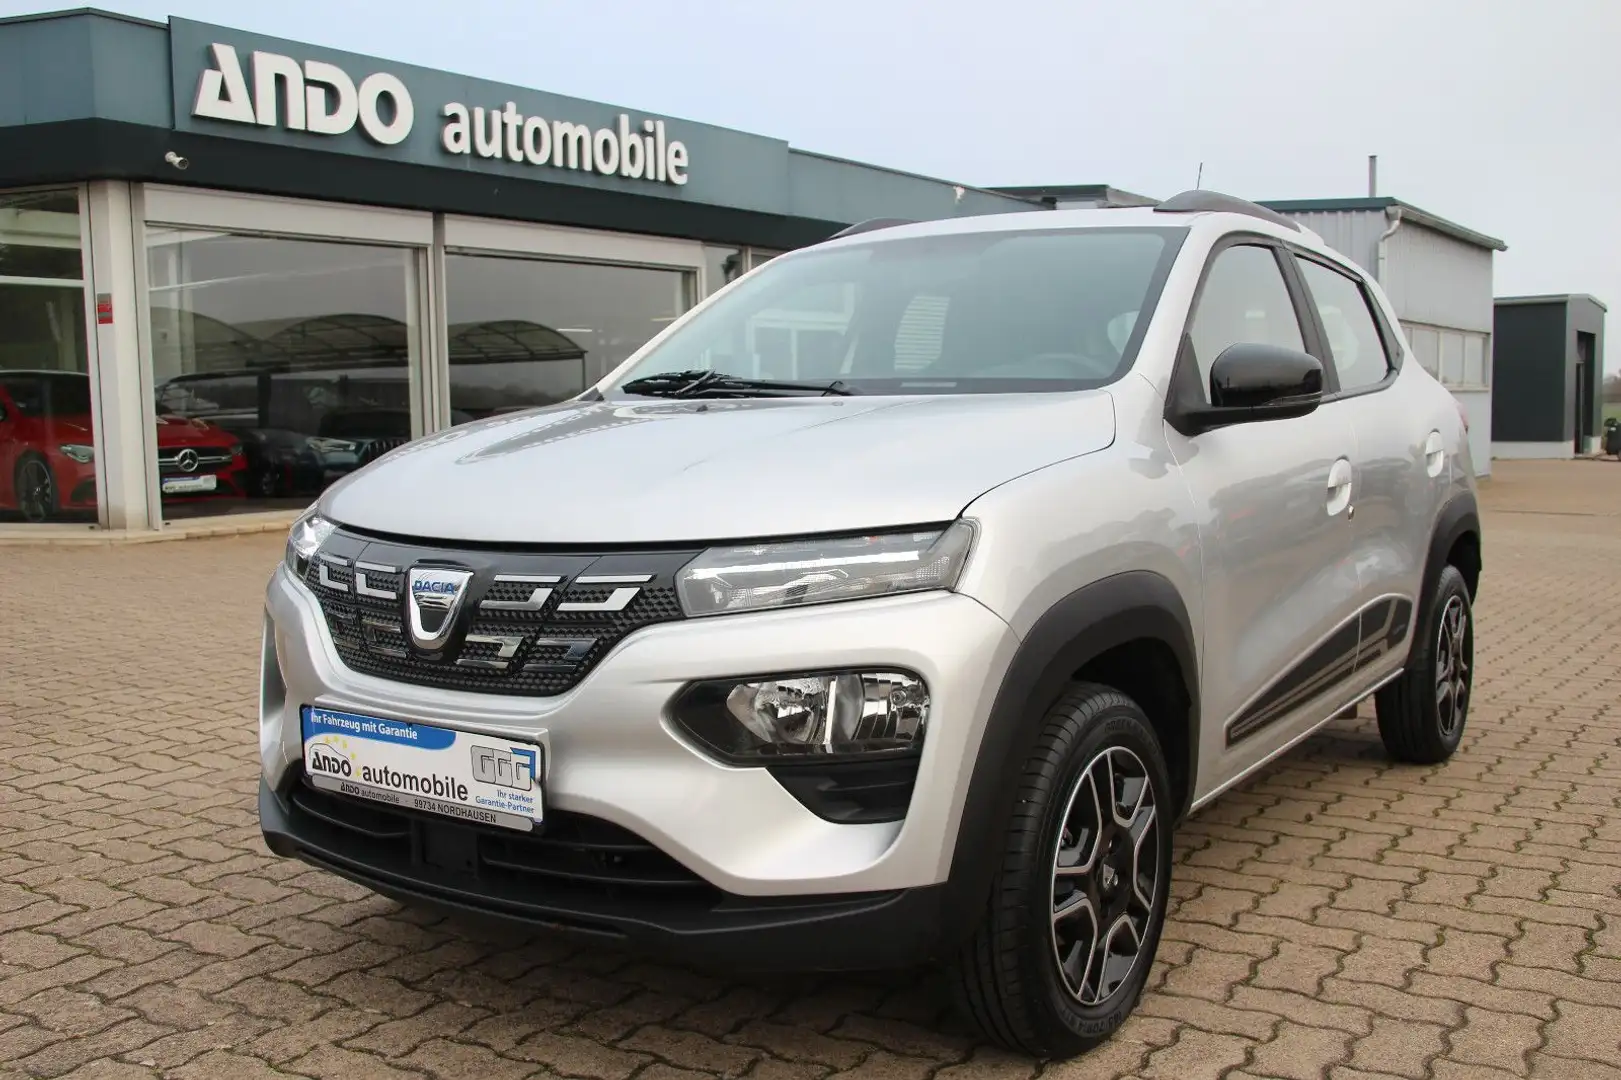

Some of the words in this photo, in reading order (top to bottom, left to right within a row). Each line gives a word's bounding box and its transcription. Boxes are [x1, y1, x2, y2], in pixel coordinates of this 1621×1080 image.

[191, 43, 415, 146] ANDO
[441, 101, 689, 186] automobile
[413, 581, 456, 595] DACIA
[311, 712, 321, 723] Ihr
[323, 714, 360, 732] Fahrzeug
[361, 722, 377, 733] mit
[378, 724, 418, 740] Garantie
[312, 751, 352, 778] ANDO
[362, 765, 469, 801] automobile
[340, 782, 360, 796] ANDO
[361, 789, 400, 804] automobile
[414, 798, 436, 811] 99734
[437, 803, 497, 823] NORDHAUSEN
[475, 795, 535, 814] Garantie-Partner
[497, 789, 507, 799] Ihr
[508, 792, 534, 804] starker
